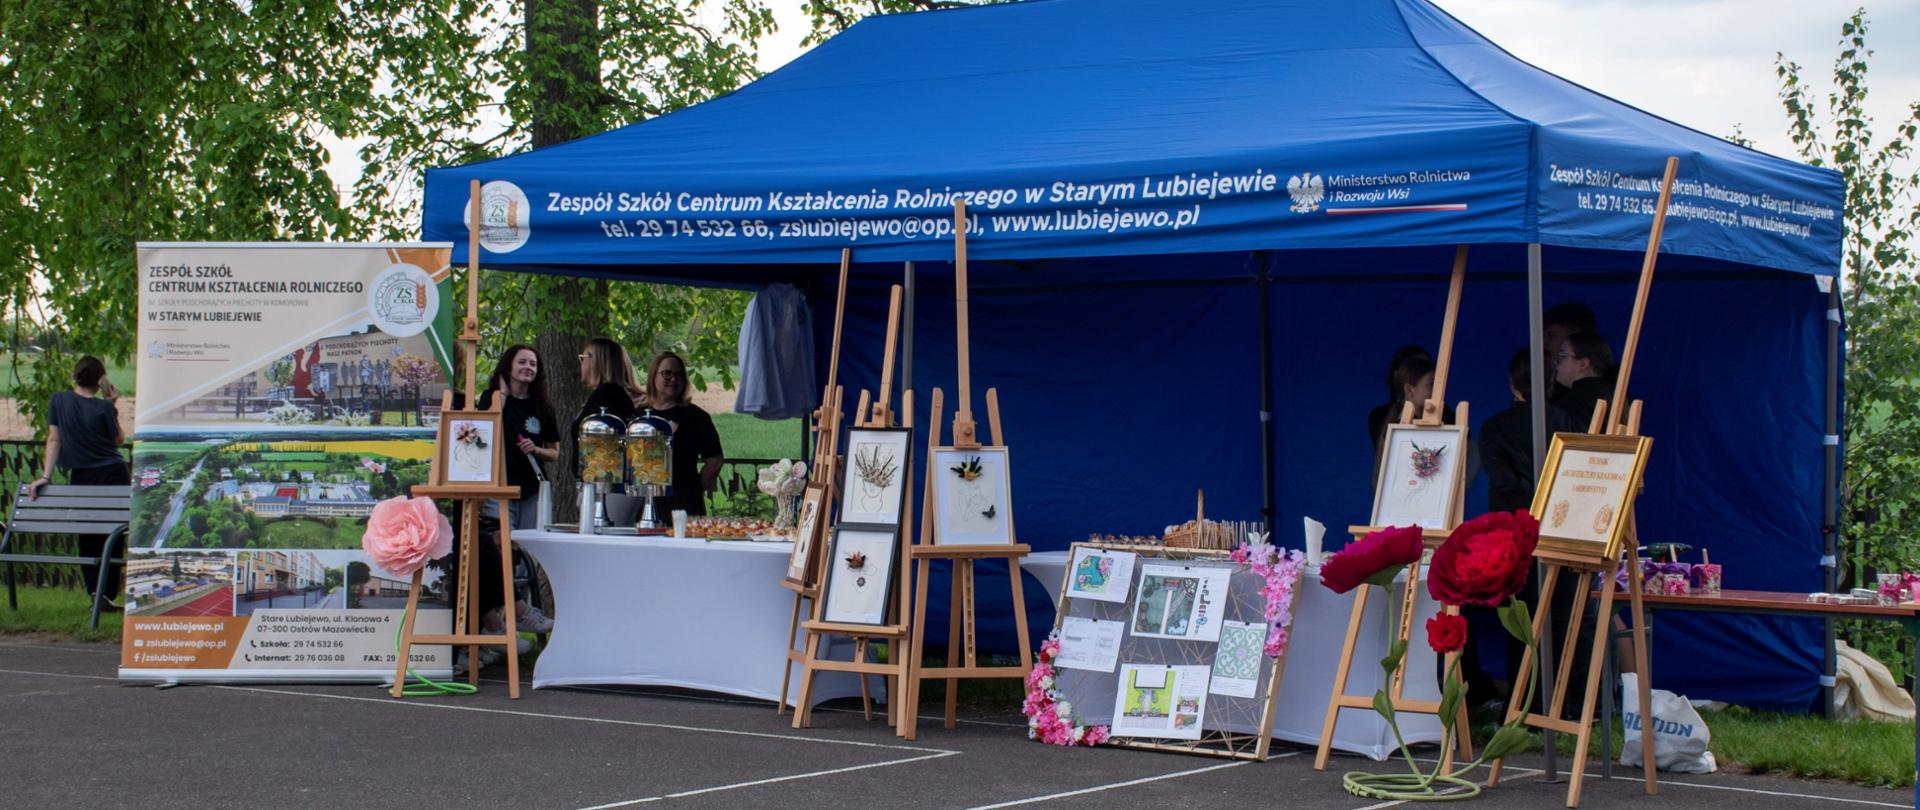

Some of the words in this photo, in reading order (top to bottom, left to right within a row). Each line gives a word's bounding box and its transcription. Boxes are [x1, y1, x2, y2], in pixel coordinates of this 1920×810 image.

[1328, 173, 1407, 188] Ministerstwo
[1409, 170, 1470, 184] Rolnictwa
[547, 192, 613, 215] Zespół
[617, 191, 672, 212] Szkół
[677, 191, 763, 212] Centrum
[767, 188, 889, 211] Kształcenia
[893, 185, 1018, 209] Rolniczego
[1025, 187, 1045, 203] w
[1049, 180, 1135, 205] Starym
[1142, 168, 1277, 200] Lubiejewie
[1329, 191, 1333, 202] i
[1335, 189, 1385, 203] Rozwoju
[1387, 187, 1411, 199] Wsi
[1550, 164, 1584, 187] Zespół
[1585, 169, 1611, 188] Szkół
[1612, 172, 1651, 193] Centrum
[1651, 177, 1702, 197] Ksałcenia
[1704, 181, 1751, 207] Rolniczego
[1752, 194, 1760, 207] w
[1761, 193, 1791, 214] Starym
[1792, 199, 1835, 221] Lubiejewie
[1577, 192, 1593, 209] tel.
[1595, 194, 1607, 210] 29
[1609, 196, 1621, 212] 74
[1623, 196, 1640, 213] 532
[1741, 213, 1812, 239] www.lubiejewo.pl
[600, 220, 635, 237] tel.
[636, 219, 664, 237] 29
[666, 219, 695, 237] 74
[696, 219, 737, 238] 532
[741, 219, 774, 240] 66,
[992, 205, 1200, 233] www.lubiejewo.pl
[149, 264, 193, 278] ZESPÓŁ
[196, 264, 233, 278] SZKÓŁ
[149, 281, 206, 293] CENTRUM
[208, 281, 287, 293] KSZTAŁCENIA
[290, 281, 364, 293] ROLNICZEGO
[395, 287, 412, 299] ZS
[148, 312, 157, 321] W
[159, 311, 202, 321] STARYM
[204, 311, 262, 322] LUBIEJEWIE
[286, 615, 331, 624] Lubiejewo,
[345, 615, 382, 623] Klonowa
[134, 621, 224, 633] www.lubiejewo.pl
[257, 625, 288, 633] 07-300
[290, 625, 320, 633] Ostrów
[322, 625, 376, 633] Mazowiecka
[146, 639, 227, 650] zslubiejewo@op.pl
[260, 640, 290, 648] Szkoła:
[294, 640, 303, 648] 29
[305, 640, 315, 648] 74
[317, 640, 331, 648] 532
[333, 640, 344, 648] 66
[254, 654, 291, 662] Internat:
[294, 654, 304, 662] 29
[306, 654, 316, 662] 76
[317, 654, 333, 662] 036
[334, 654, 345, 662] 08
[363, 654, 383, 662] FAX:
[386, 654, 396, 662] 29
[409, 654, 424, 662] 532
[425, 654, 436, 662] 66
